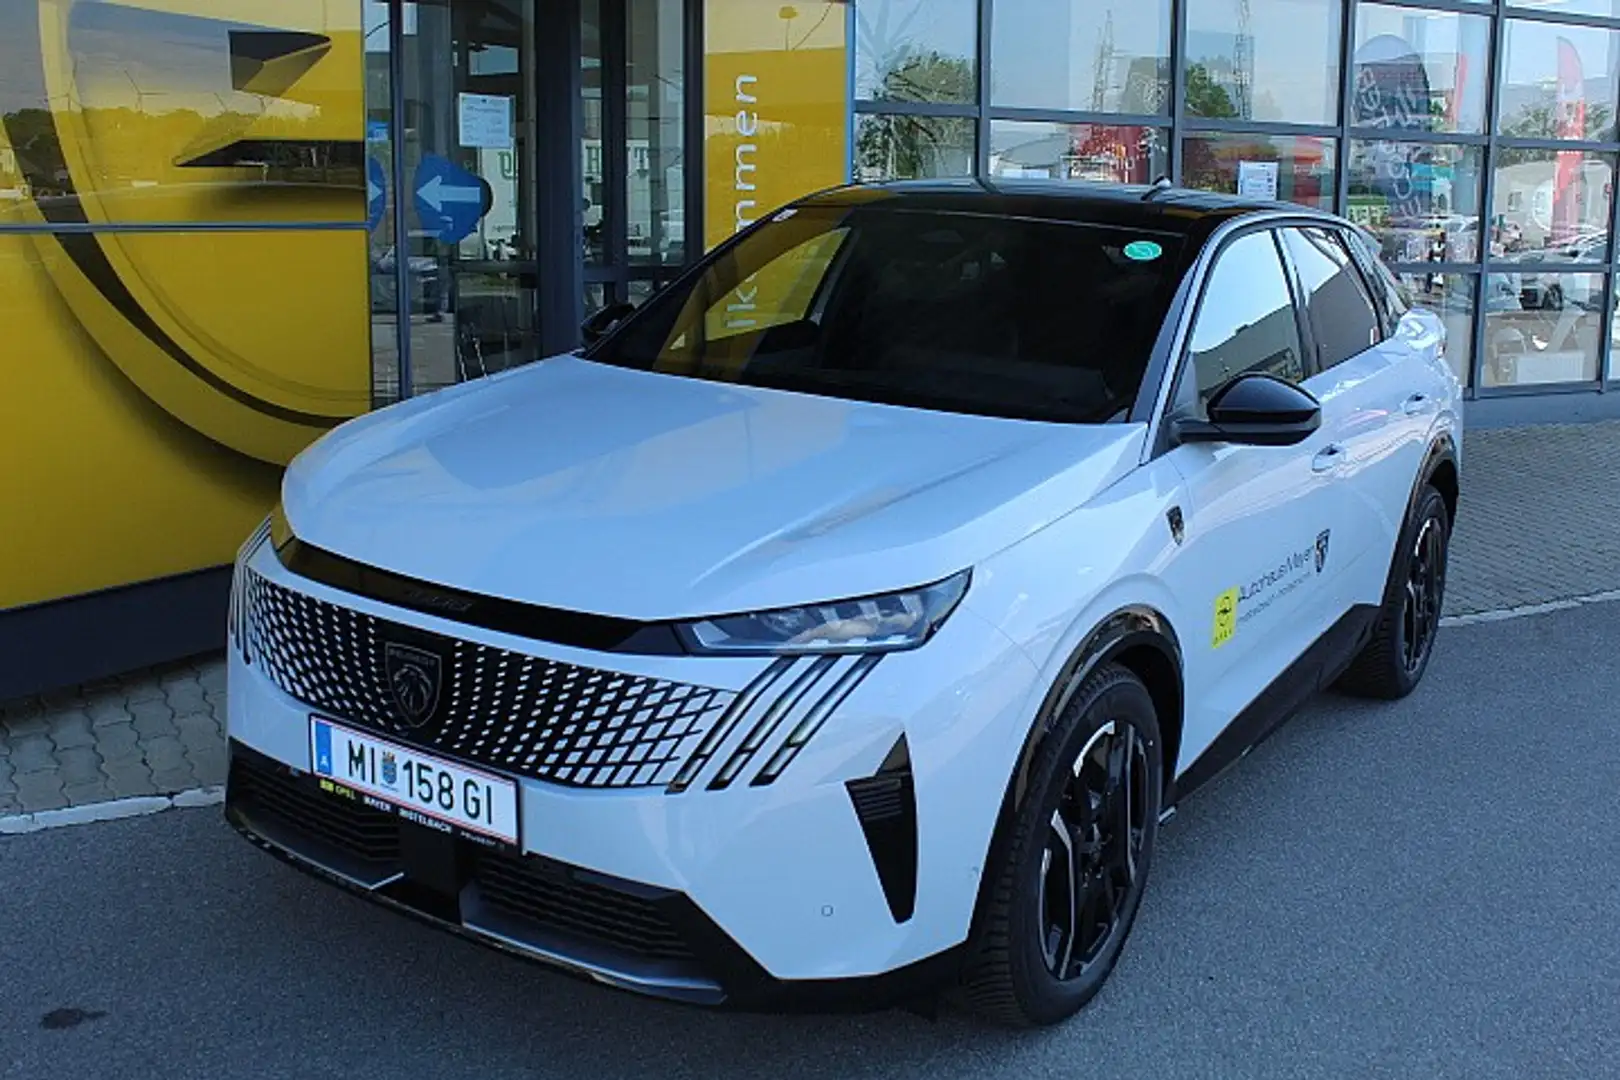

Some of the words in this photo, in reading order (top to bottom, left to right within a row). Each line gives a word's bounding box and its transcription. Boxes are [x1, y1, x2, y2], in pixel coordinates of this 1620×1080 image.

[725, 74, 758, 329] lkmmen
[319, 755, 329, 768] A
[347, 739, 376, 785] MI
[402, 759, 454, 811] 158
[463, 778, 492, 826] GI
